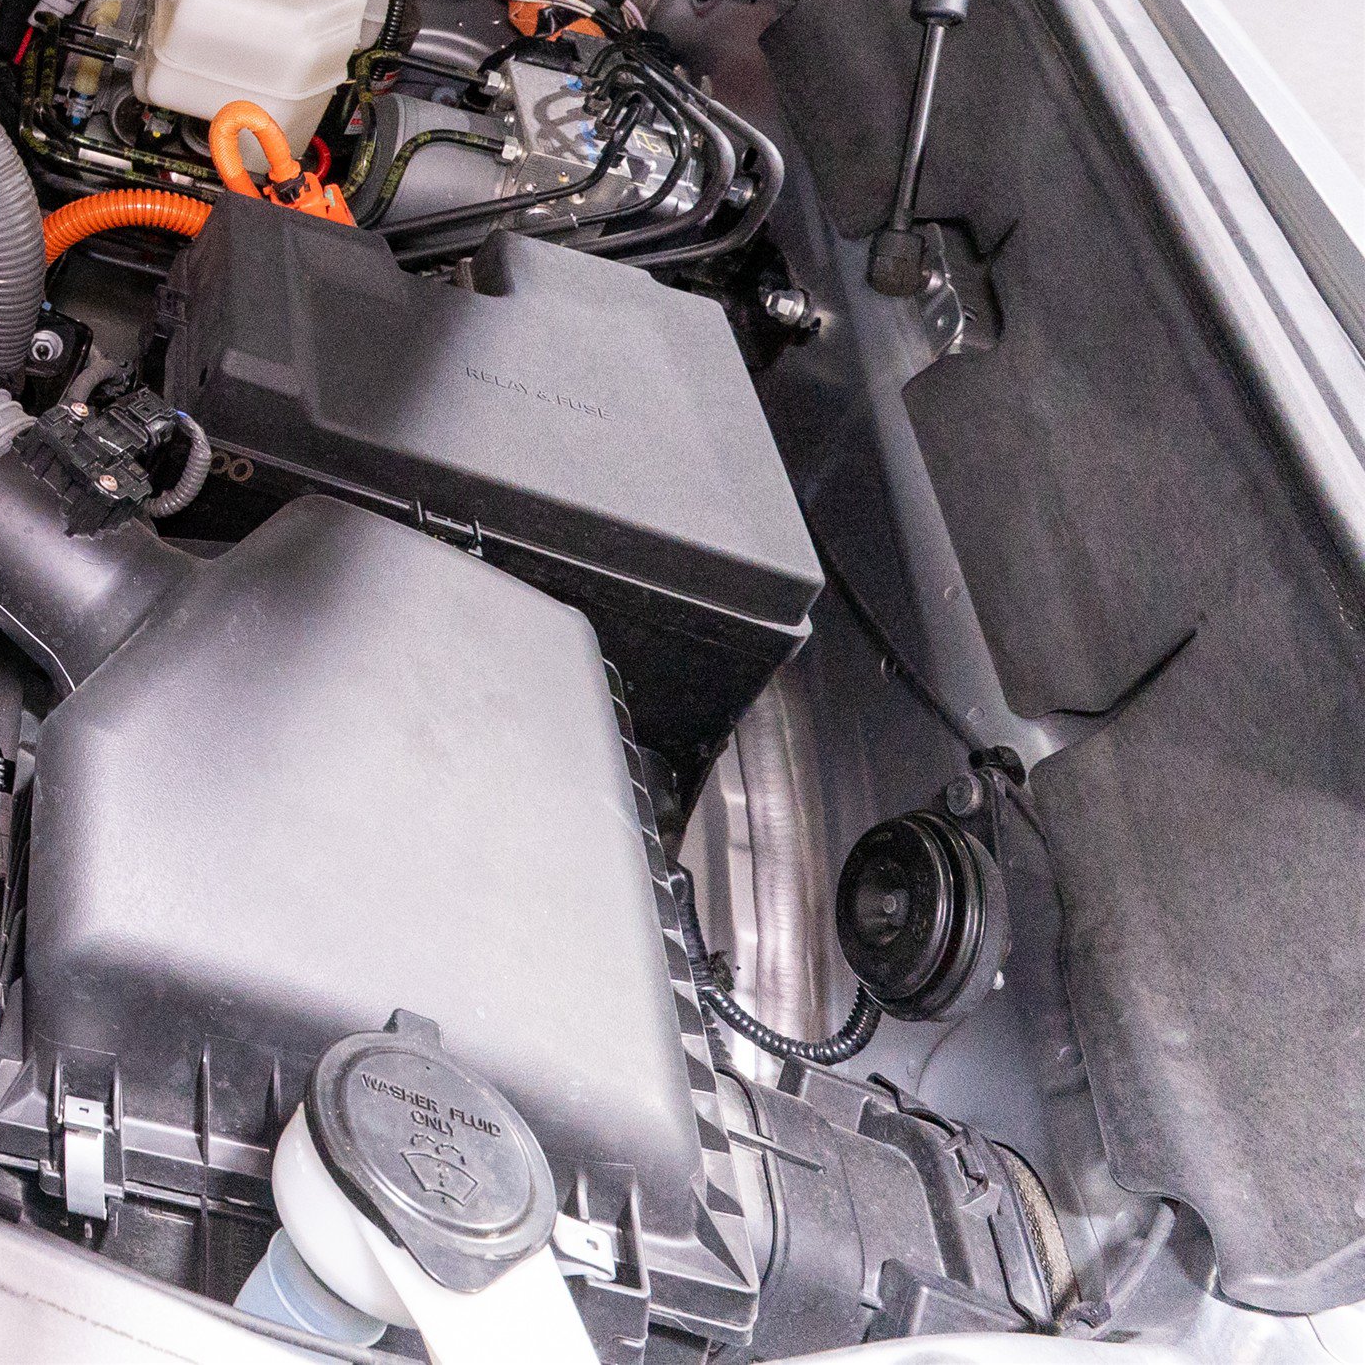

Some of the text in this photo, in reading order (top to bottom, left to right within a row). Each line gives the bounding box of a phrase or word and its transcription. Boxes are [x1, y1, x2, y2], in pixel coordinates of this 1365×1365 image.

[465, 366, 531, 395] RELAY
[556, 394, 617, 421] FUSE
[360, 1072, 502, 1138] WASHER FLUID
[411, 1109, 456, 1138] ONLY
